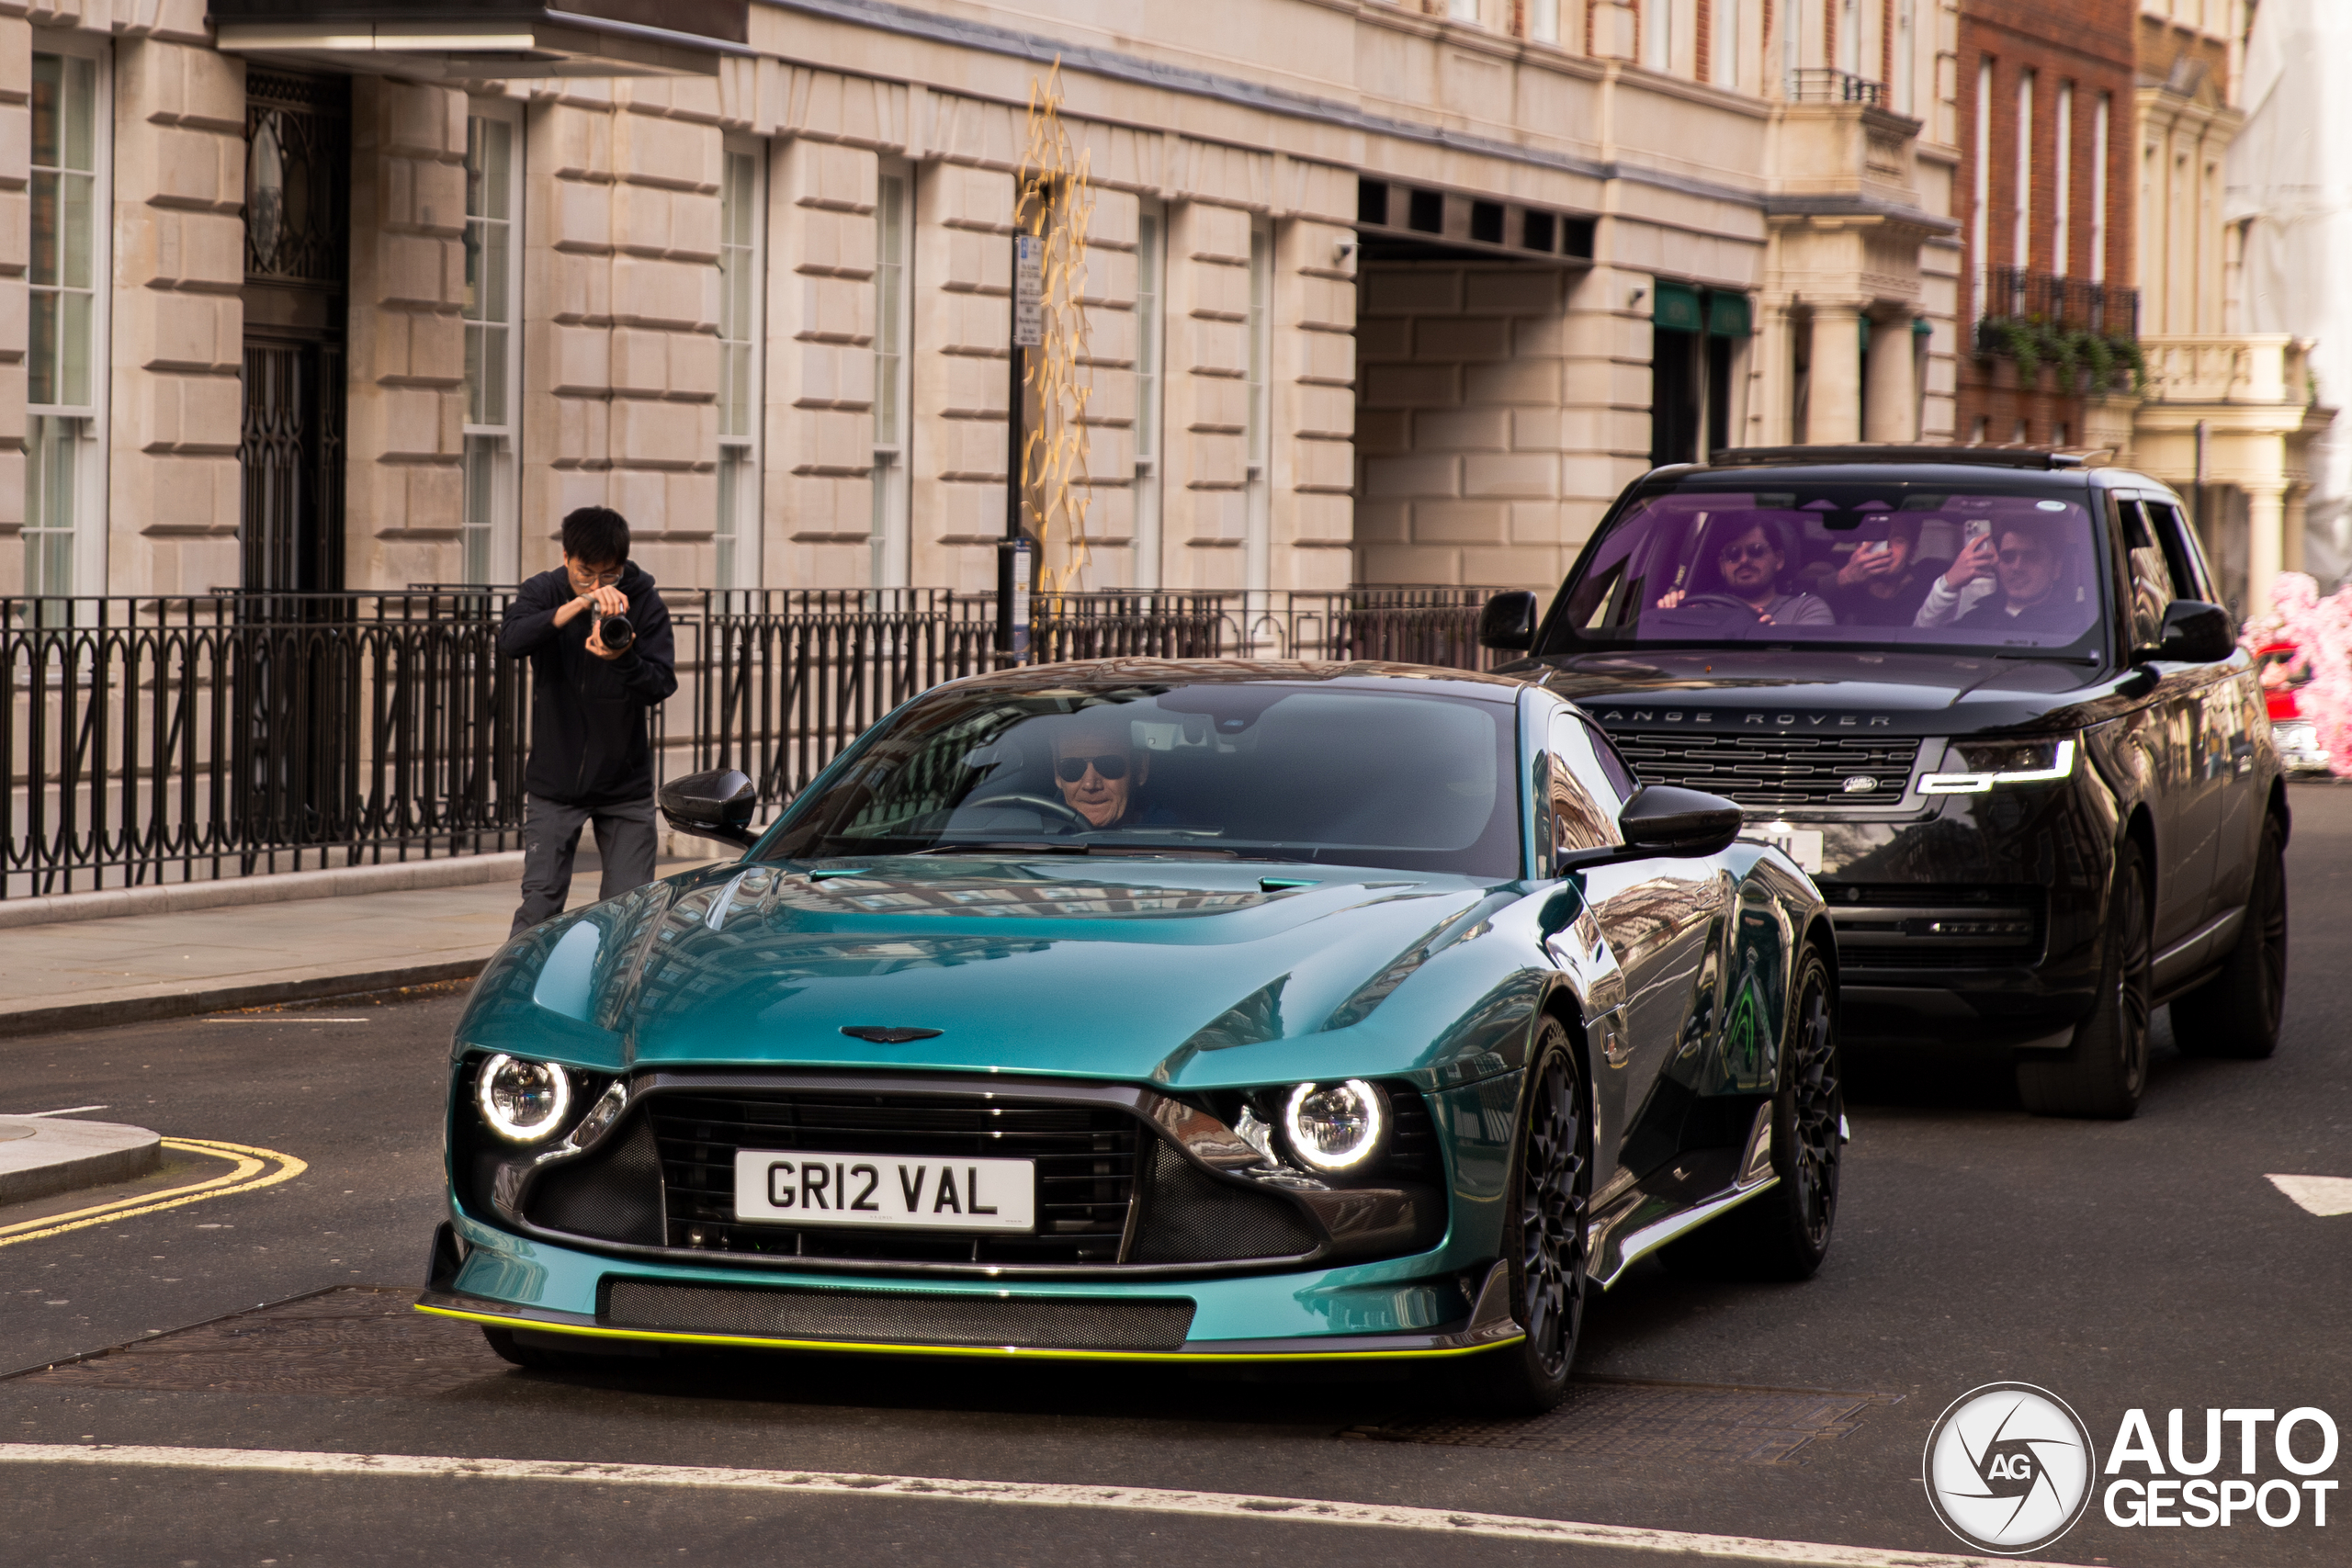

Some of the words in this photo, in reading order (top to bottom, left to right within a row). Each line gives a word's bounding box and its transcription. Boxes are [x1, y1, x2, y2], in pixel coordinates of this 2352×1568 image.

[1745, 714, 1891, 727] ROVER
[766, 1160, 879, 1212] GR12
[898, 1164, 998, 1215] VAL
